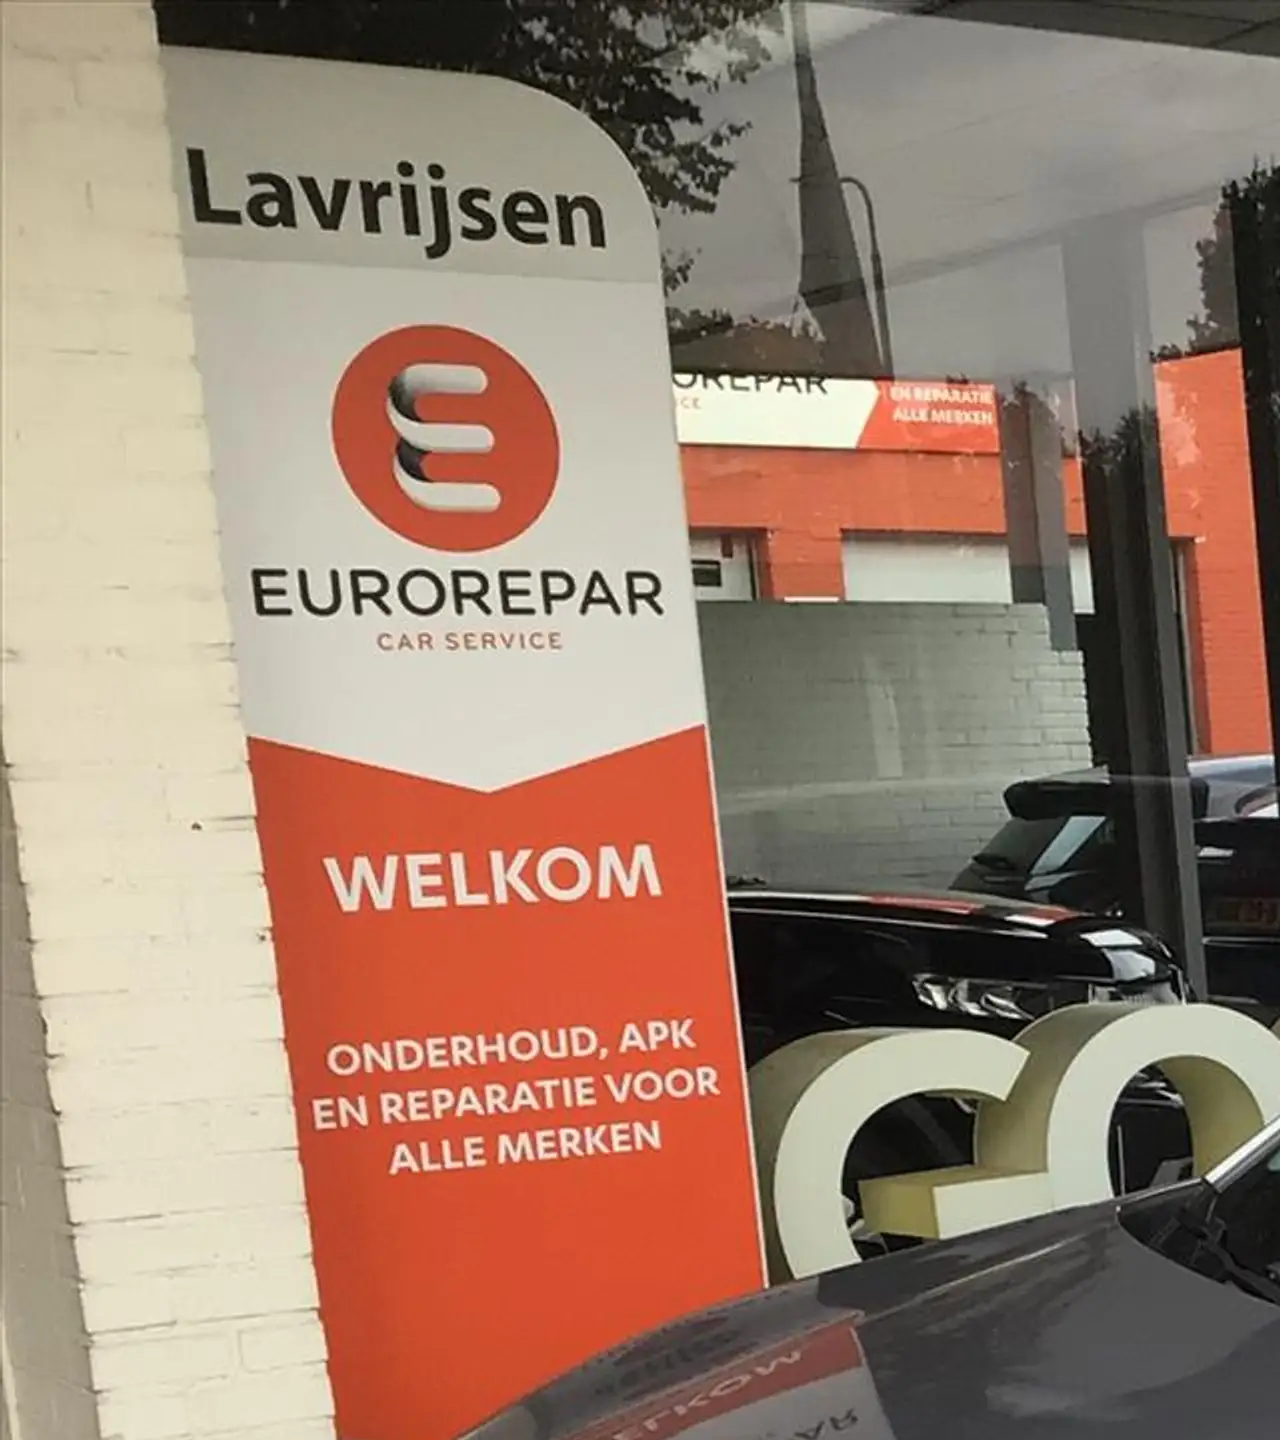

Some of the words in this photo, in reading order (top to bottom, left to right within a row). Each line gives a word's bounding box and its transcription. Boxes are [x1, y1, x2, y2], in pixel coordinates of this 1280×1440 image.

[185, 146, 608, 260] Lavrijsen
[251, 568, 664, 616] EUROREPAR
[376, 632, 434, 651] CAR
[445, 631, 563, 651] SERVICE
[322, 843, 663, 913] WELKOM
[326, 1026, 609, 1076] ONDERHOUD,
[619, 1018, 696, 1054] APK
[312, 1097, 369, 1131] EN
[380, 1075, 598, 1125] REPARATIE
[604, 1065, 721, 1104] VOOR
[388, 1136, 487, 1176] ALLE
[497, 1119, 662, 1164] MERKEN
